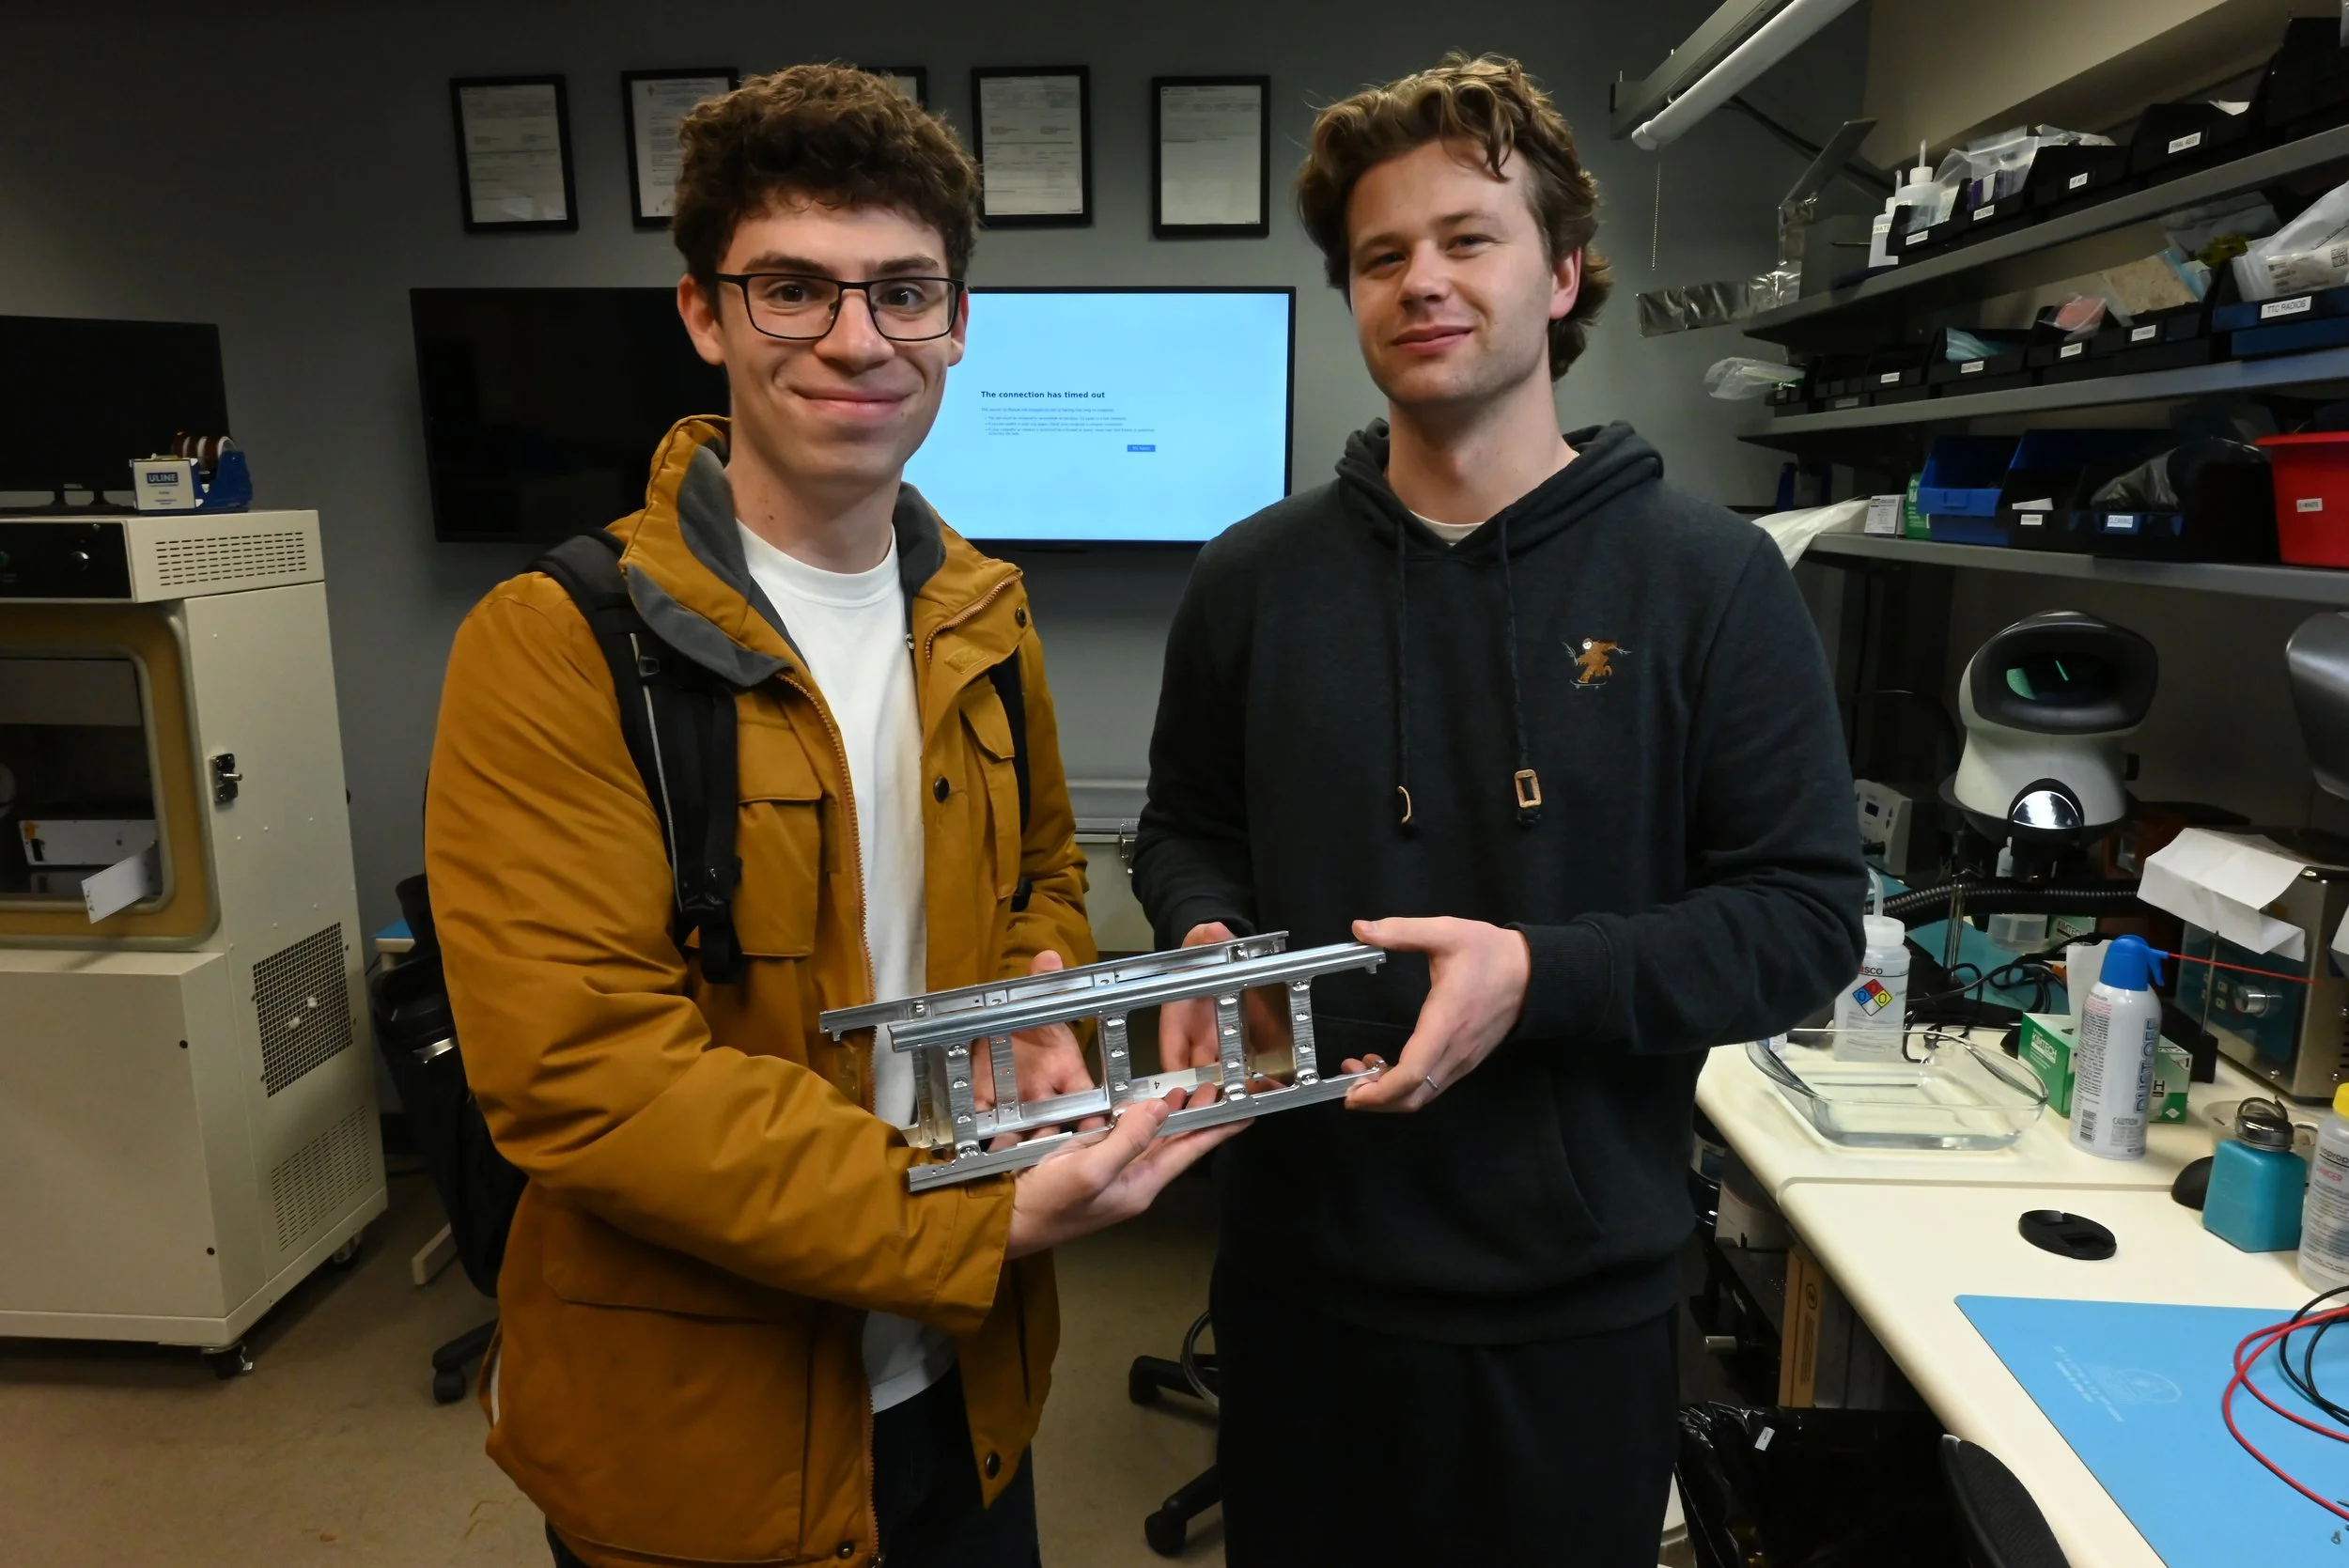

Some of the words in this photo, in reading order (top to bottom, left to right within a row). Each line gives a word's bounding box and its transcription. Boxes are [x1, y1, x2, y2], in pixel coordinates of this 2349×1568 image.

[2266, 303, 2280, 315] TTC
[2281, 299, 2307, 311] RADIOS
[148, 474, 177, 482] ULINE
[1859, 965, 1883, 975] SCO
[1858, 991, 1867, 1002] 0
[1878, 992, 1887, 1004] 0
[2031, 1032, 2058, 1060] KIMTECH
[1154, 1081, 1160, 1090] 4
[2112, 1116, 2139, 1126] CAUTION
